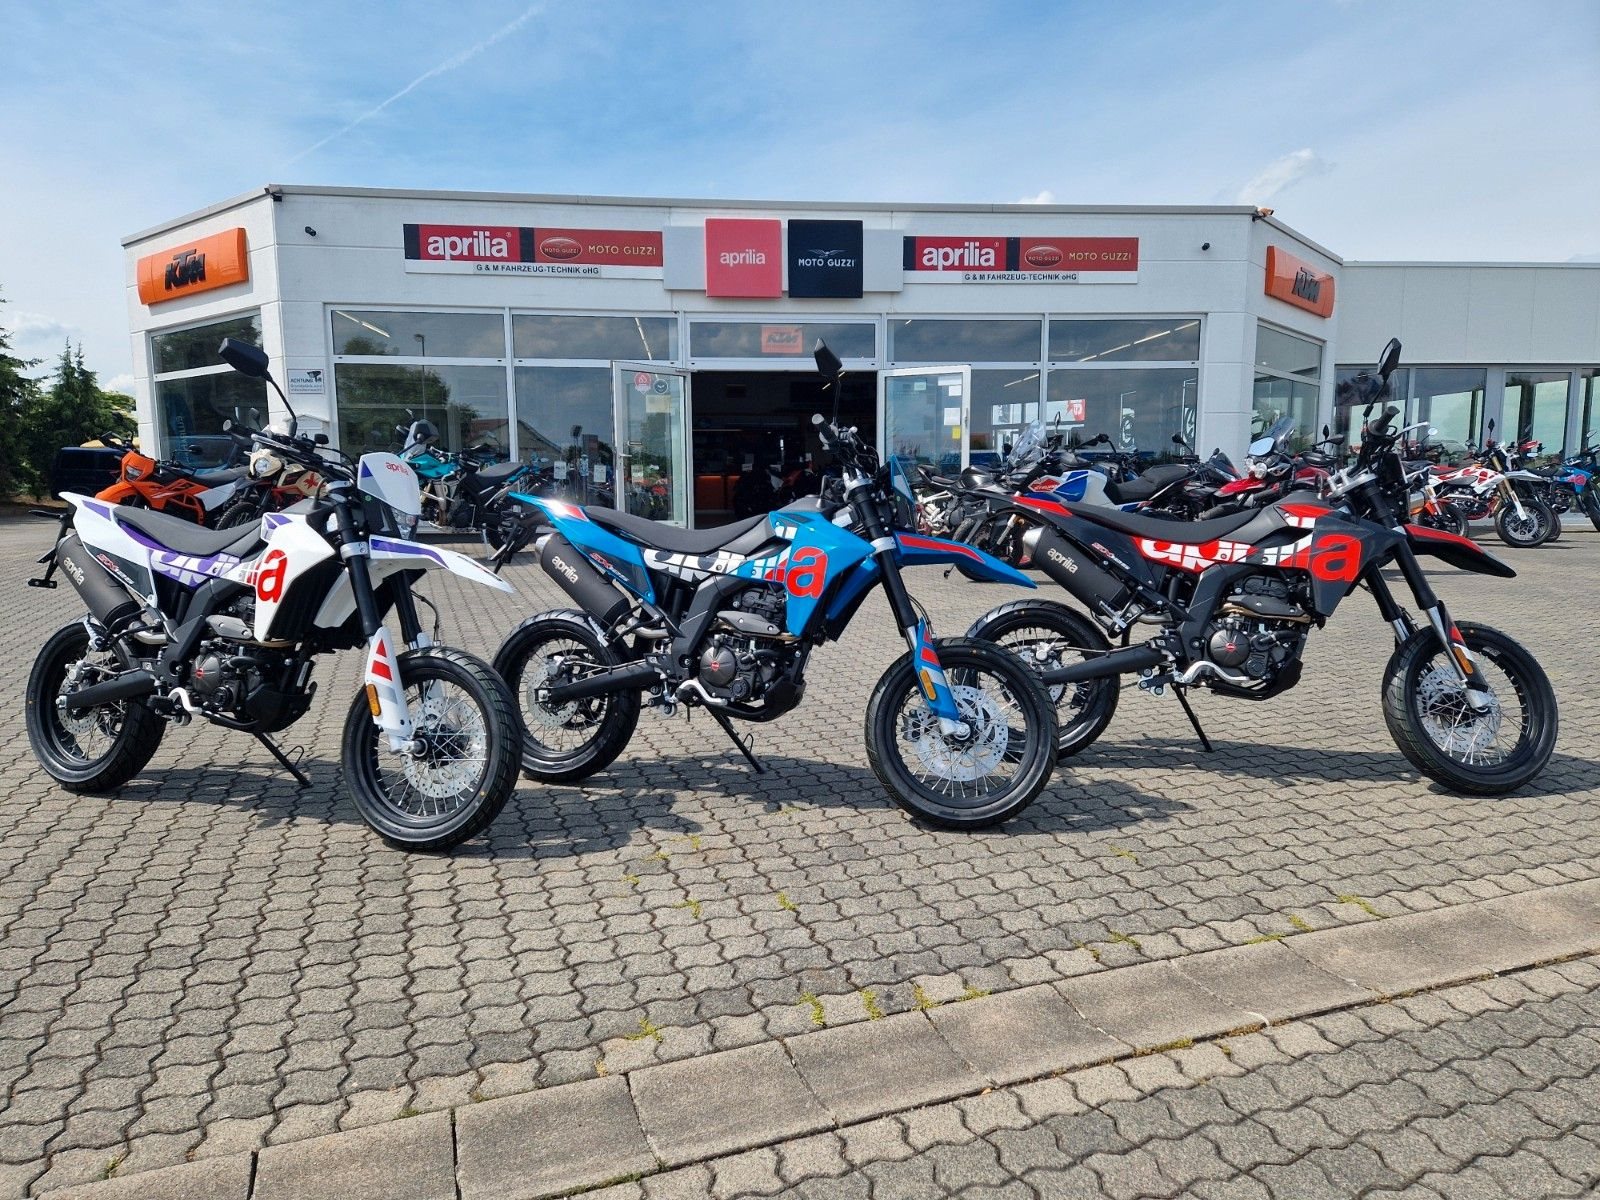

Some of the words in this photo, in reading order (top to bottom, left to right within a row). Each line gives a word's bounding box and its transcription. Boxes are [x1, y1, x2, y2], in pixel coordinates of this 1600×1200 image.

[427, 230, 508, 260] aprilia
[588, 245, 619, 254] MOTO
[624, 246, 656, 255] GUZZI
[719, 249, 766, 267] aprilia
[922, 241, 995, 270] aprilia
[1068, 252, 1098, 261] MOTO
[1101, 252, 1132, 261] GUZZI
[165, 248, 207, 291] KTM
[492, 264, 500, 272] M
[501, 264, 581, 274] FAHRZEUG-TECHNIK
[798, 258, 824, 267] MOTO
[827, 258, 855, 267] GUZZI
[987, 273, 1060, 281] FAHRZEUG-TECHNIK
[1291, 266, 1320, 304] KTM
[63, 556, 85, 587] aprilia
[552, 555, 579, 584] aprilia
[1047, 547, 1079, 574] aprilia
